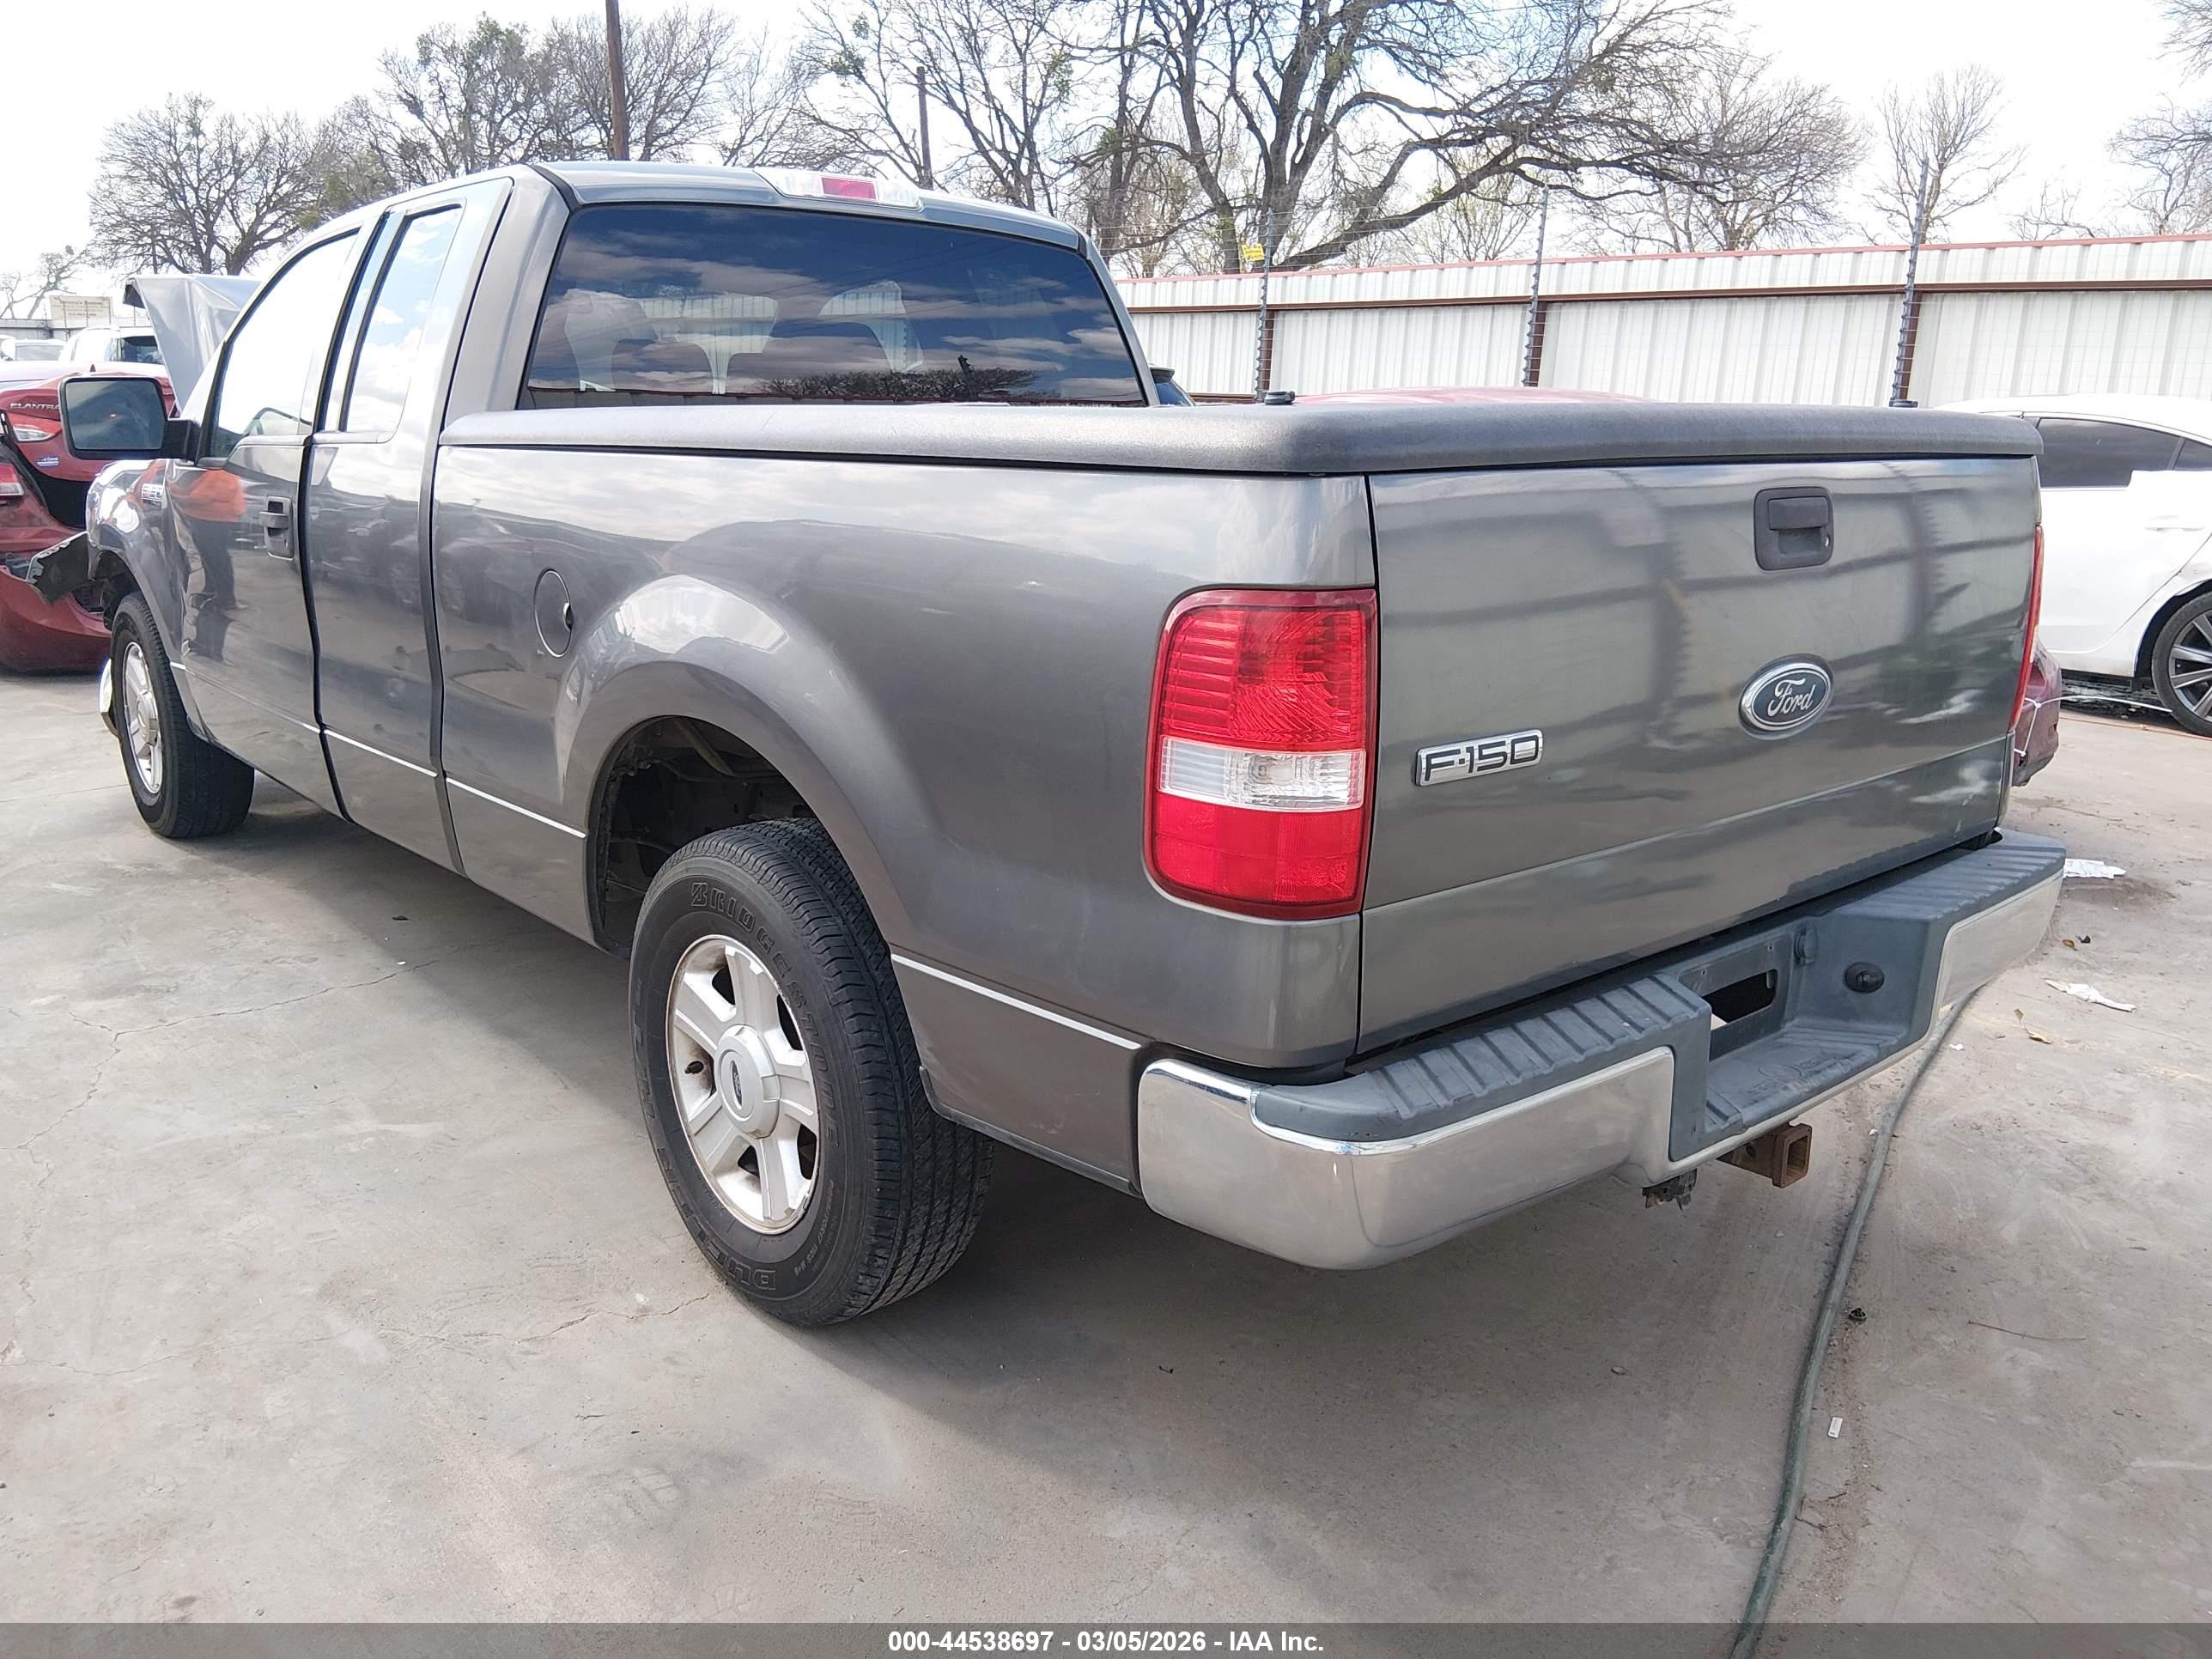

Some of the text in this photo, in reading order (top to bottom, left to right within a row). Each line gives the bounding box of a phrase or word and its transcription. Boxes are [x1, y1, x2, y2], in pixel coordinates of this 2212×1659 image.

[1767, 678, 1816, 716] Ford
[1424, 734, 1540, 782] F-150
[690, 881, 840, 1149] BRIDGESTONE
